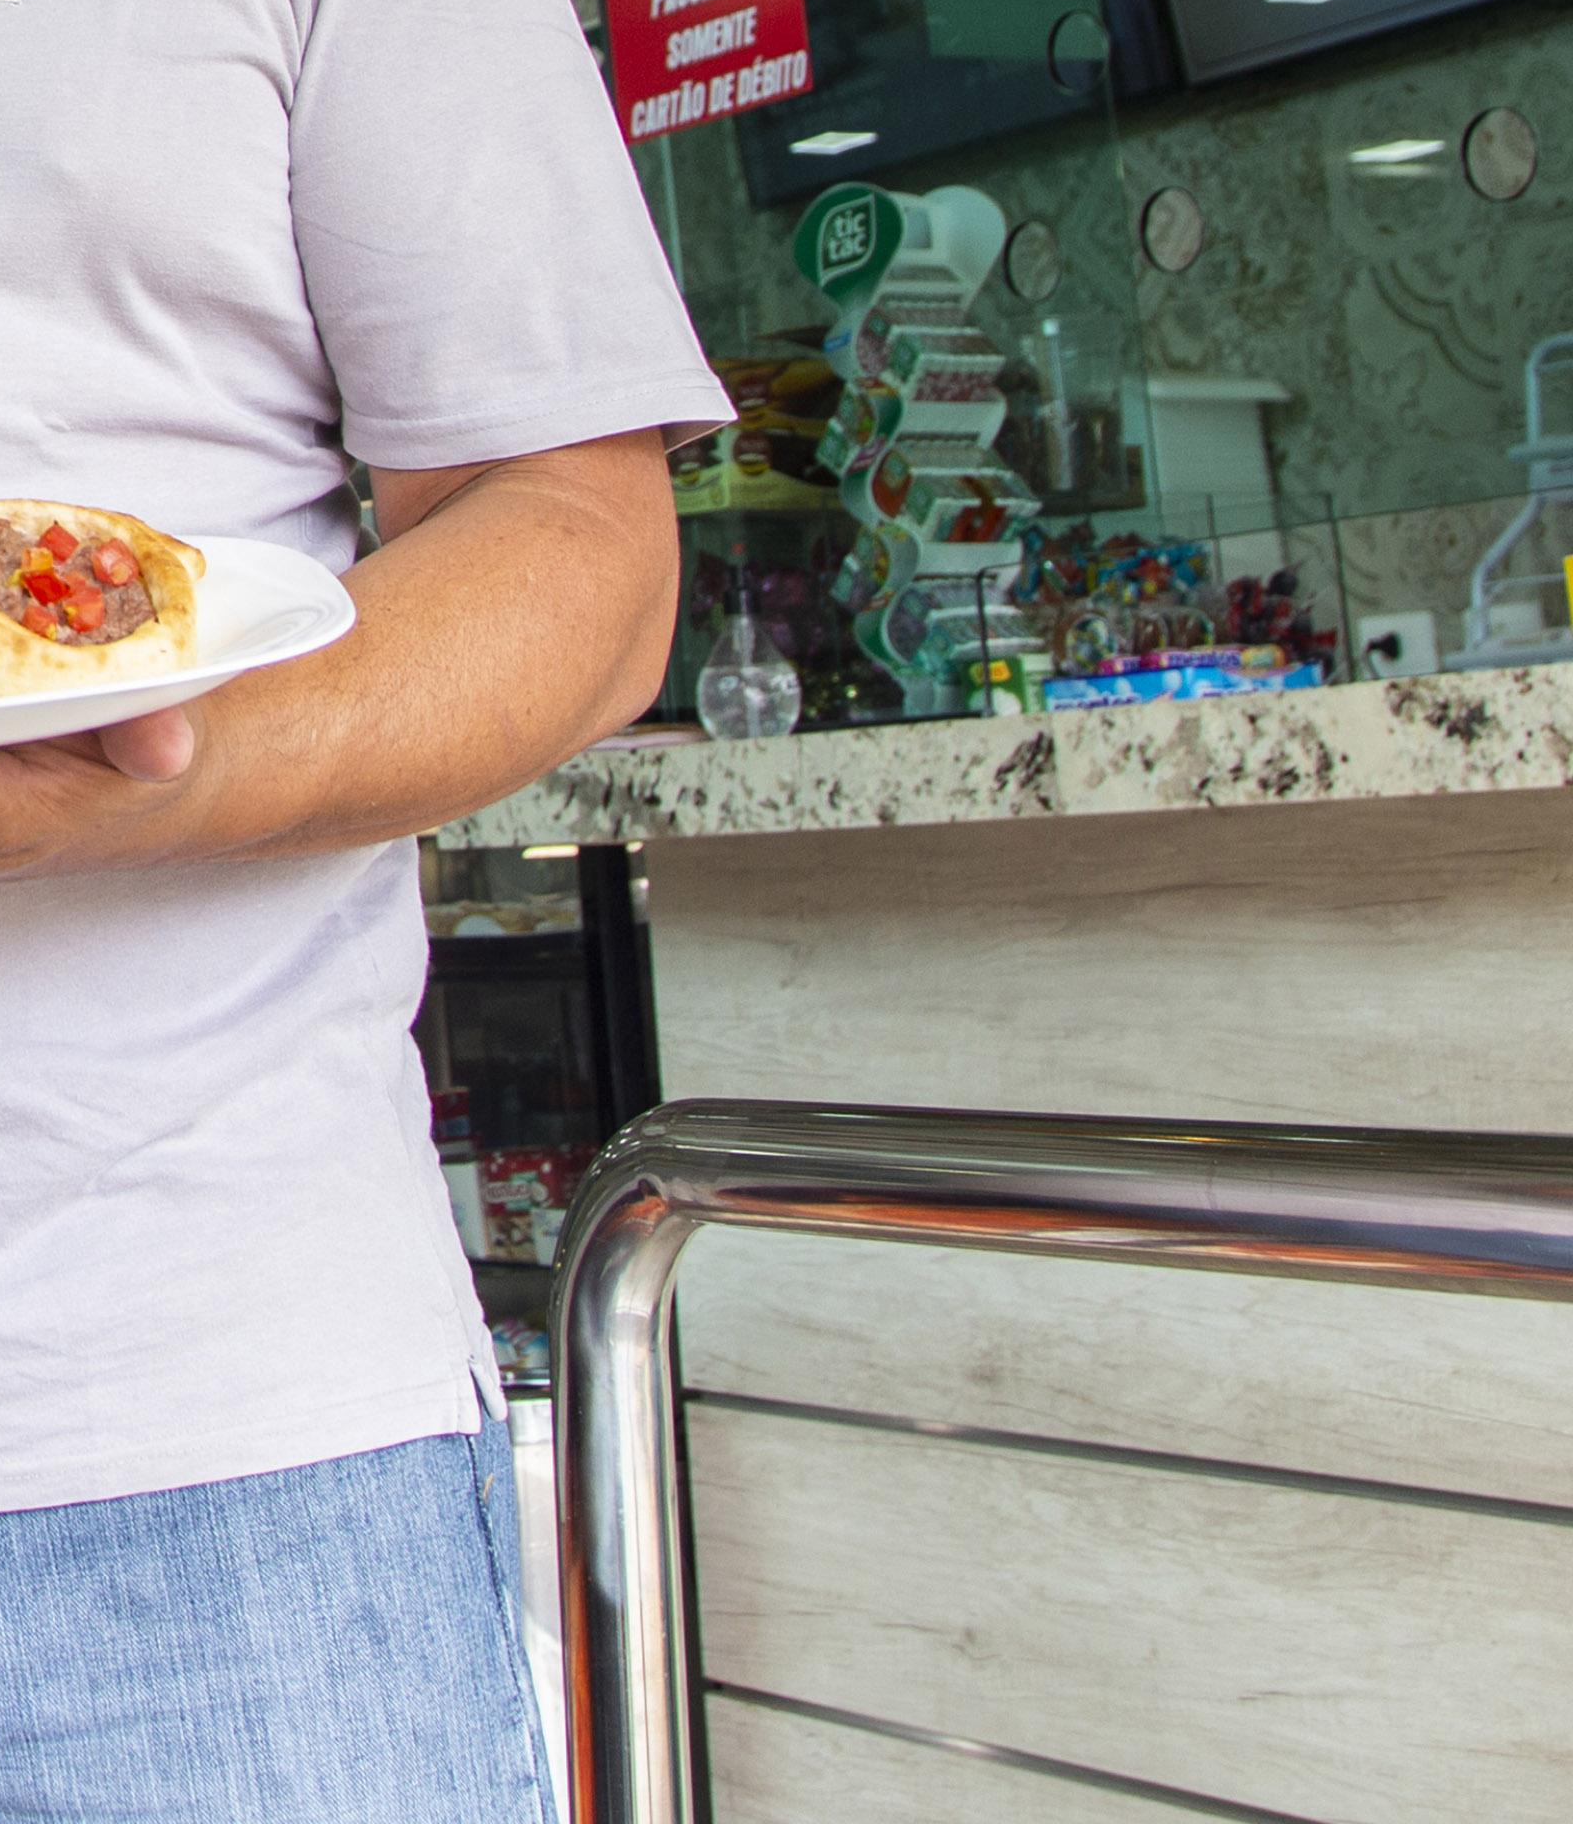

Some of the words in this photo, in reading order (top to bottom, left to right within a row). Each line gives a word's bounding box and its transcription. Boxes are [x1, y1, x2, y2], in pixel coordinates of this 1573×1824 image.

[666, 6, 758, 71] SOMENTE
[630, 80, 706, 137] CARTÃO
[708, 71, 735, 115] DE
[736, 49, 808, 107] DÉBITO
[834, 209, 867, 238] tic
[828, 232, 867, 263] tac
[1169, 650, 1241, 668] mentos
